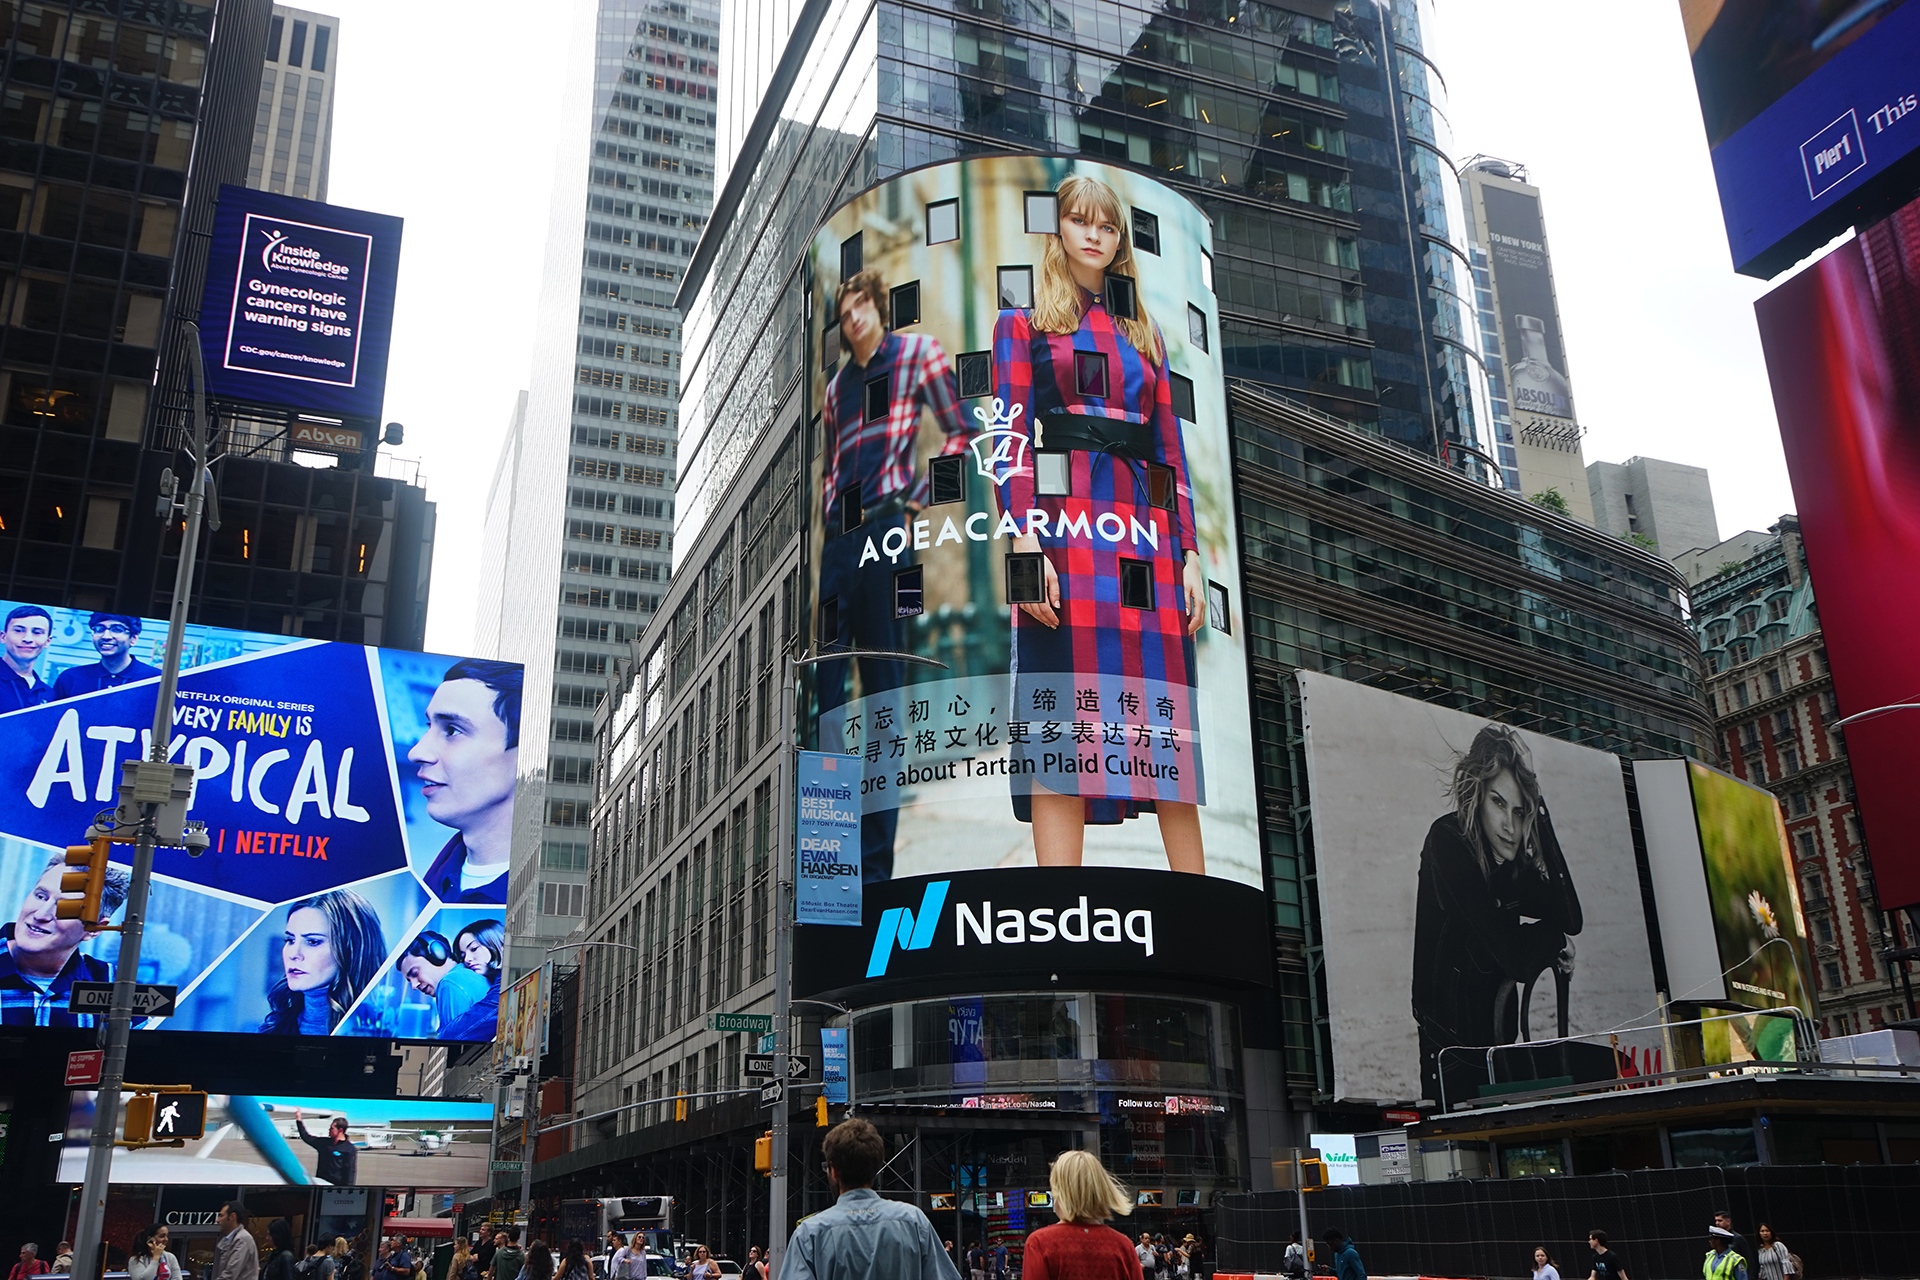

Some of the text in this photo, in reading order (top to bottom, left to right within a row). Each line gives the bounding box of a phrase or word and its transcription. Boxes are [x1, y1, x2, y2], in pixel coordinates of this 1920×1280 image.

[1867, 94, 1918, 135] This
[1814, 133, 1851, 175] Pier1
[1490, 232, 1501, 242] TO
[1502, 235, 1520, 247] NEW
[280, 243, 321, 260] Inside
[270, 263, 348, 281] About Gynecologic Cancer
[272, 252, 350, 275] Knowledge
[248, 279, 347, 306] Gynecologic
[246, 296, 347, 321] cancers have
[244, 311, 352, 337] warning signs
[239, 345, 346, 368] CDC.gov/cancer/knowledge
[1517, 387, 1556, 406] ABSOL
[296, 427, 357, 447] Absen
[858, 508, 1159, 568] AQEACARMON
[175, 691, 315, 712] NETFLIX ORIGINAL SERIES
[172, 705, 313, 738] VERY FAMILY IS
[861, 753, 1179, 795] ore about Tartan Plaid Culture
[801, 786, 851, 801] WINNER
[801, 797, 835, 810] BEST
[801, 808, 857, 823] MUSICAL
[817, 820, 834, 828] TONY
[834, 822, 857, 830] AWARD
[235, 830, 330, 861] NETFLIX
[801, 838, 841, 852] DEAR
[801, 850, 838, 863] EVAN
[801, 862, 858, 877] HANSEN
[800, 907, 858, 915] DearEvanHansen.com
[956, 895, 1154, 957] Nasdaq
[719, 1015, 770, 1034] Broadway
[78, 1054, 95, 1062] STOPPING
[754, 1061, 801, 1071] ONE AY
[69, 1063, 86, 1071] Anytime
[1118, 1099, 1143, 1108] Follow
[493, 1161, 521, 1170] BROADWAY
[987, 1153, 1027, 1166] Nasdaq
[165, 1210, 220, 1226] CITIZ
